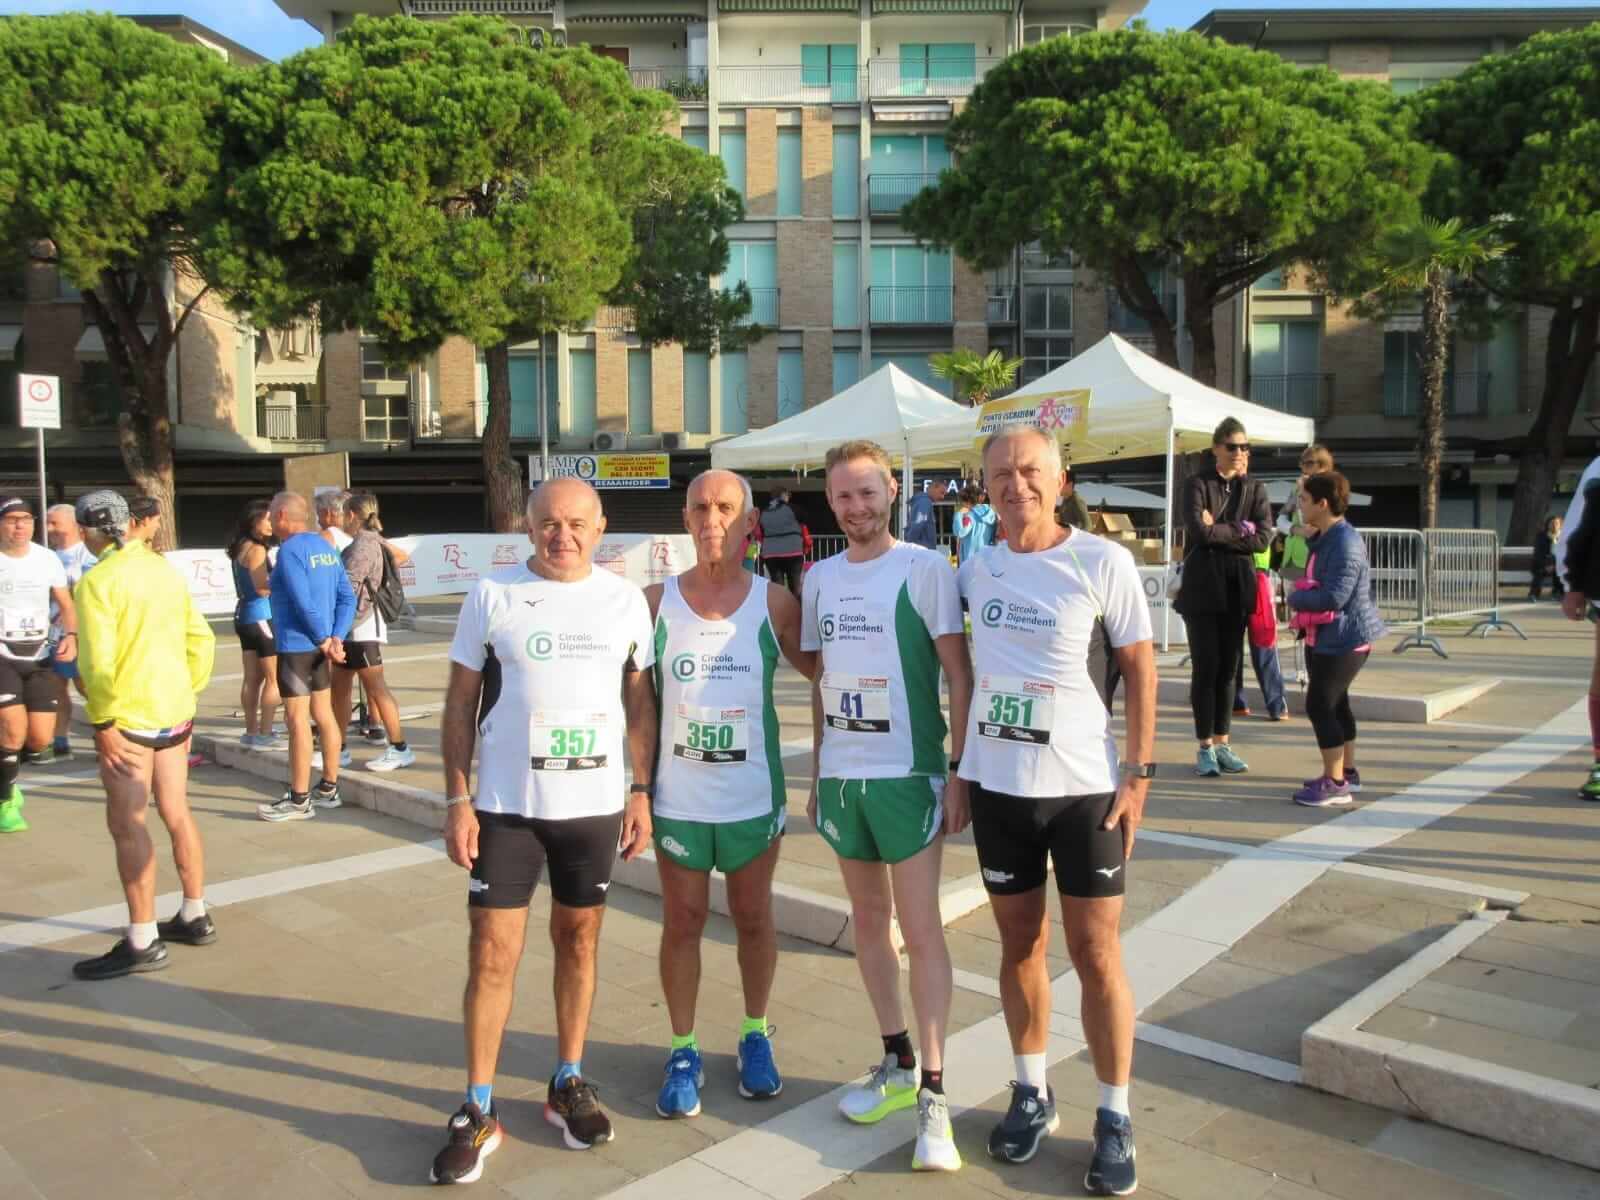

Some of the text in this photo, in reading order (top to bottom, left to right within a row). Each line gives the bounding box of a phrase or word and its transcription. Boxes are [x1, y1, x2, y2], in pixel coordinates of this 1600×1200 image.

[1008, 603, 1038, 615] Circolo
[20, 616, 34, 629] 44
[839, 614, 866, 623] Circolo
[1006, 612, 1056, 627] Dipendenti
[839, 624, 883, 633] Dipendenti
[558, 632, 592, 642] Circolo
[558, 641, 610, 652] Dipendenti
[701, 653, 733, 663] Circolo
[701, 663, 751, 674] Dipendenti
[840, 692, 863, 718] 41
[987, 694, 1034, 727] 351
[687, 722, 734, 750] 350
[550, 729, 596, 756] 357
